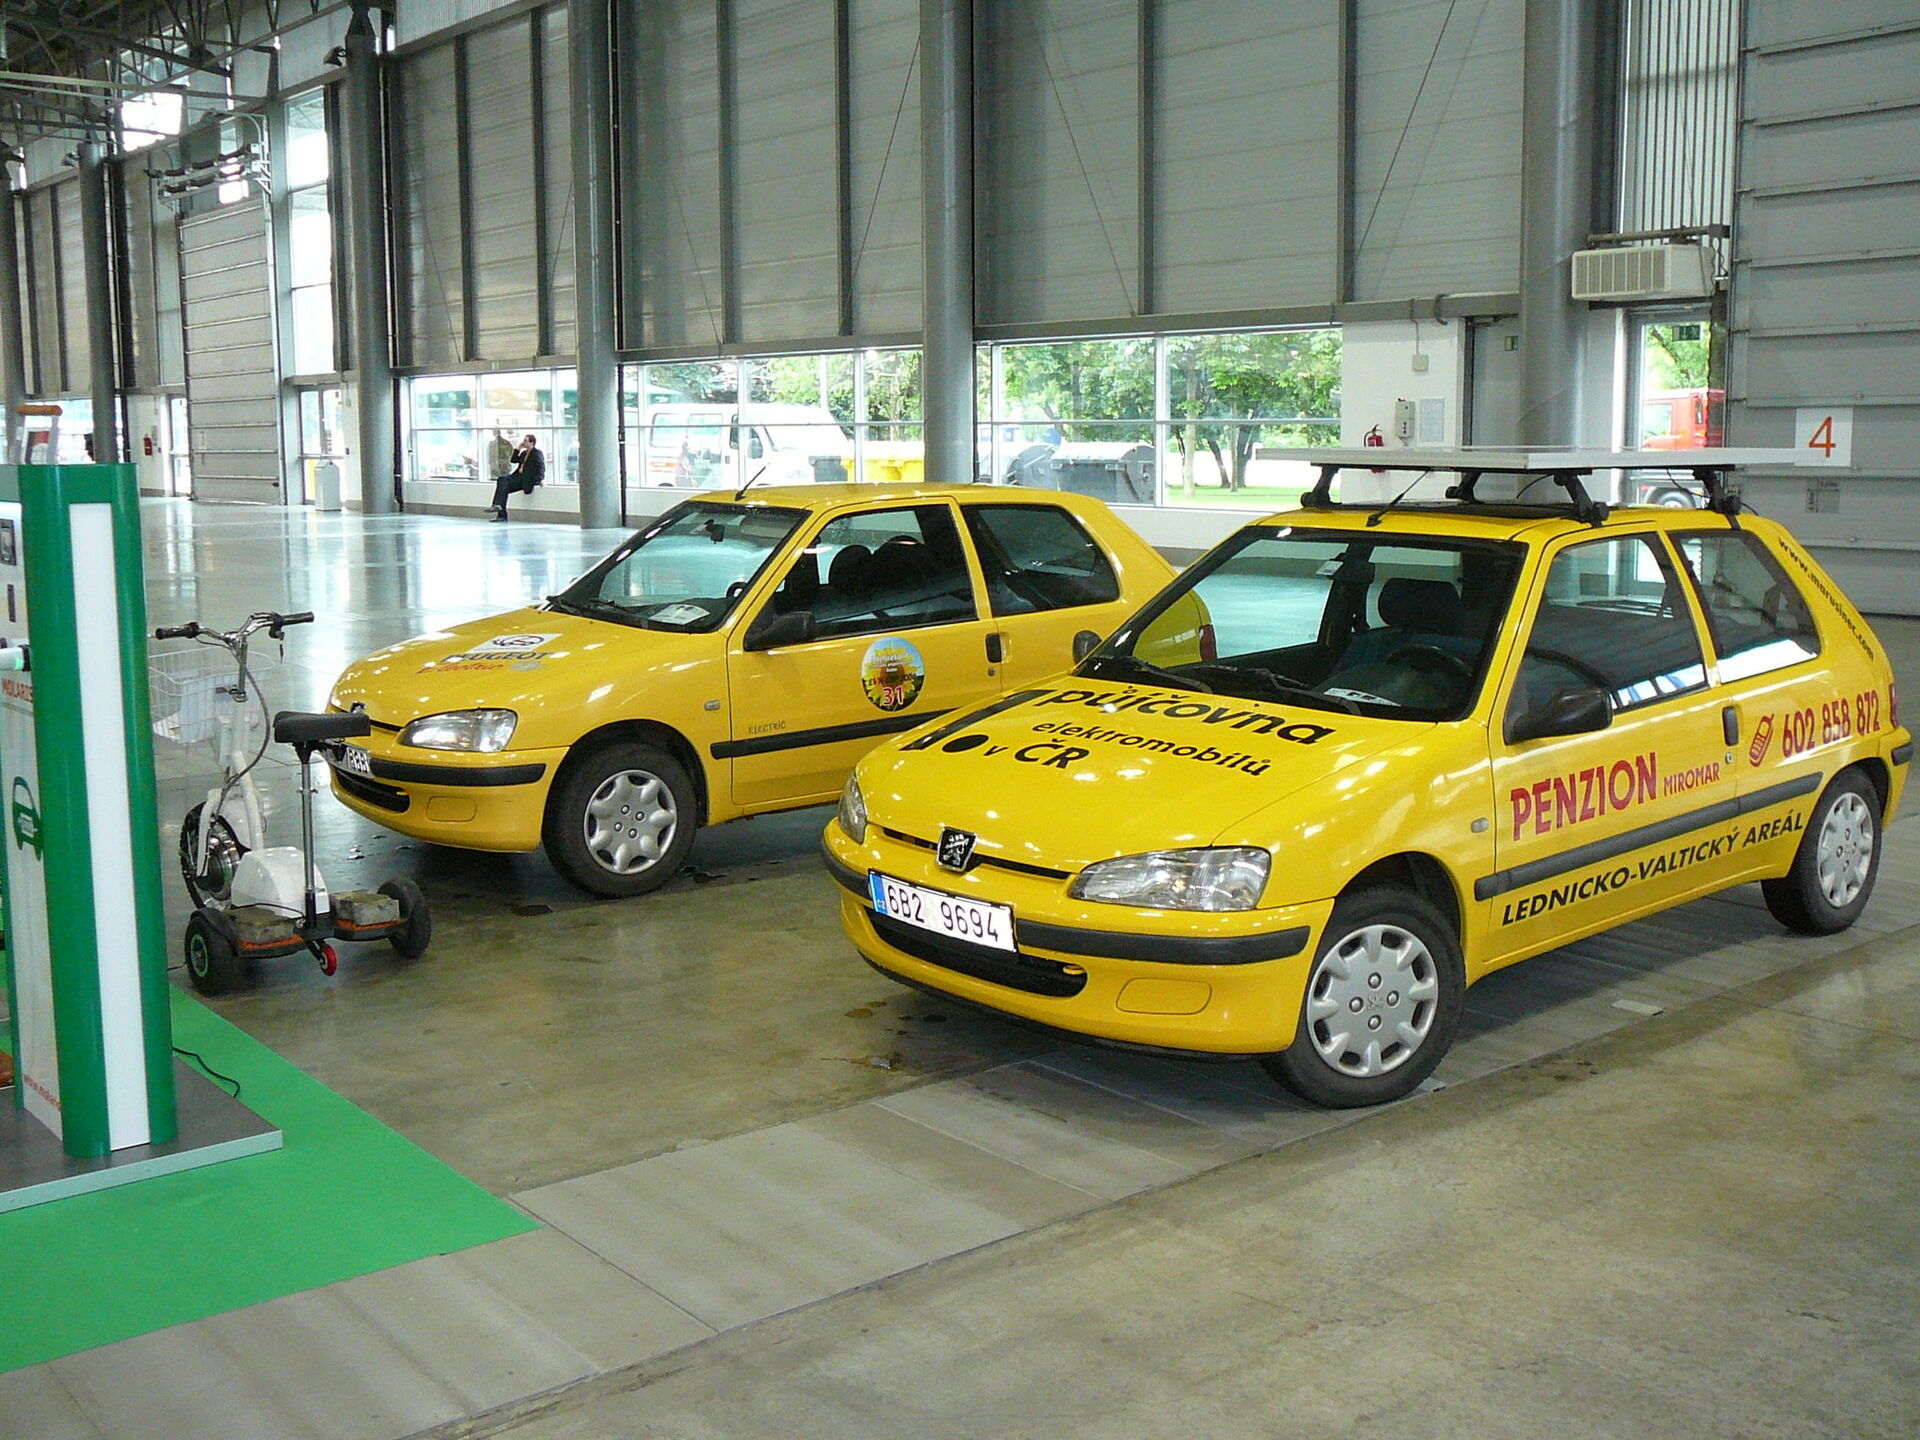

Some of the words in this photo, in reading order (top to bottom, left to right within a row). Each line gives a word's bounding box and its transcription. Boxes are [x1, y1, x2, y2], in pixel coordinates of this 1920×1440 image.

[1808, 416, 1836, 458] 4
[439, 651, 556, 664] PEUGEOT
[882, 686, 905, 706] 31
[1034, 685, 1337, 745] půjčovna
[1782, 711, 1816, 758] 602
[1822, 698, 1852, 743] 858
[1856, 689, 1881, 735] 872
[748, 720, 786, 735] ELECTRIC
[983, 744, 1009, 757] v
[1014, 738, 1090, 769] ČR
[1032, 720, 1272, 777] elektromobilů
[1510, 752, 1657, 842] PENZION
[1663, 762, 1720, 797] MIROMAR
[1502, 826, 1740, 927] LEDNICKO-VALTICKÝ
[1742, 810, 1803, 848] AREÁL
[887, 885, 925, 923] 6B2
[941, 901, 998, 942] 9694
